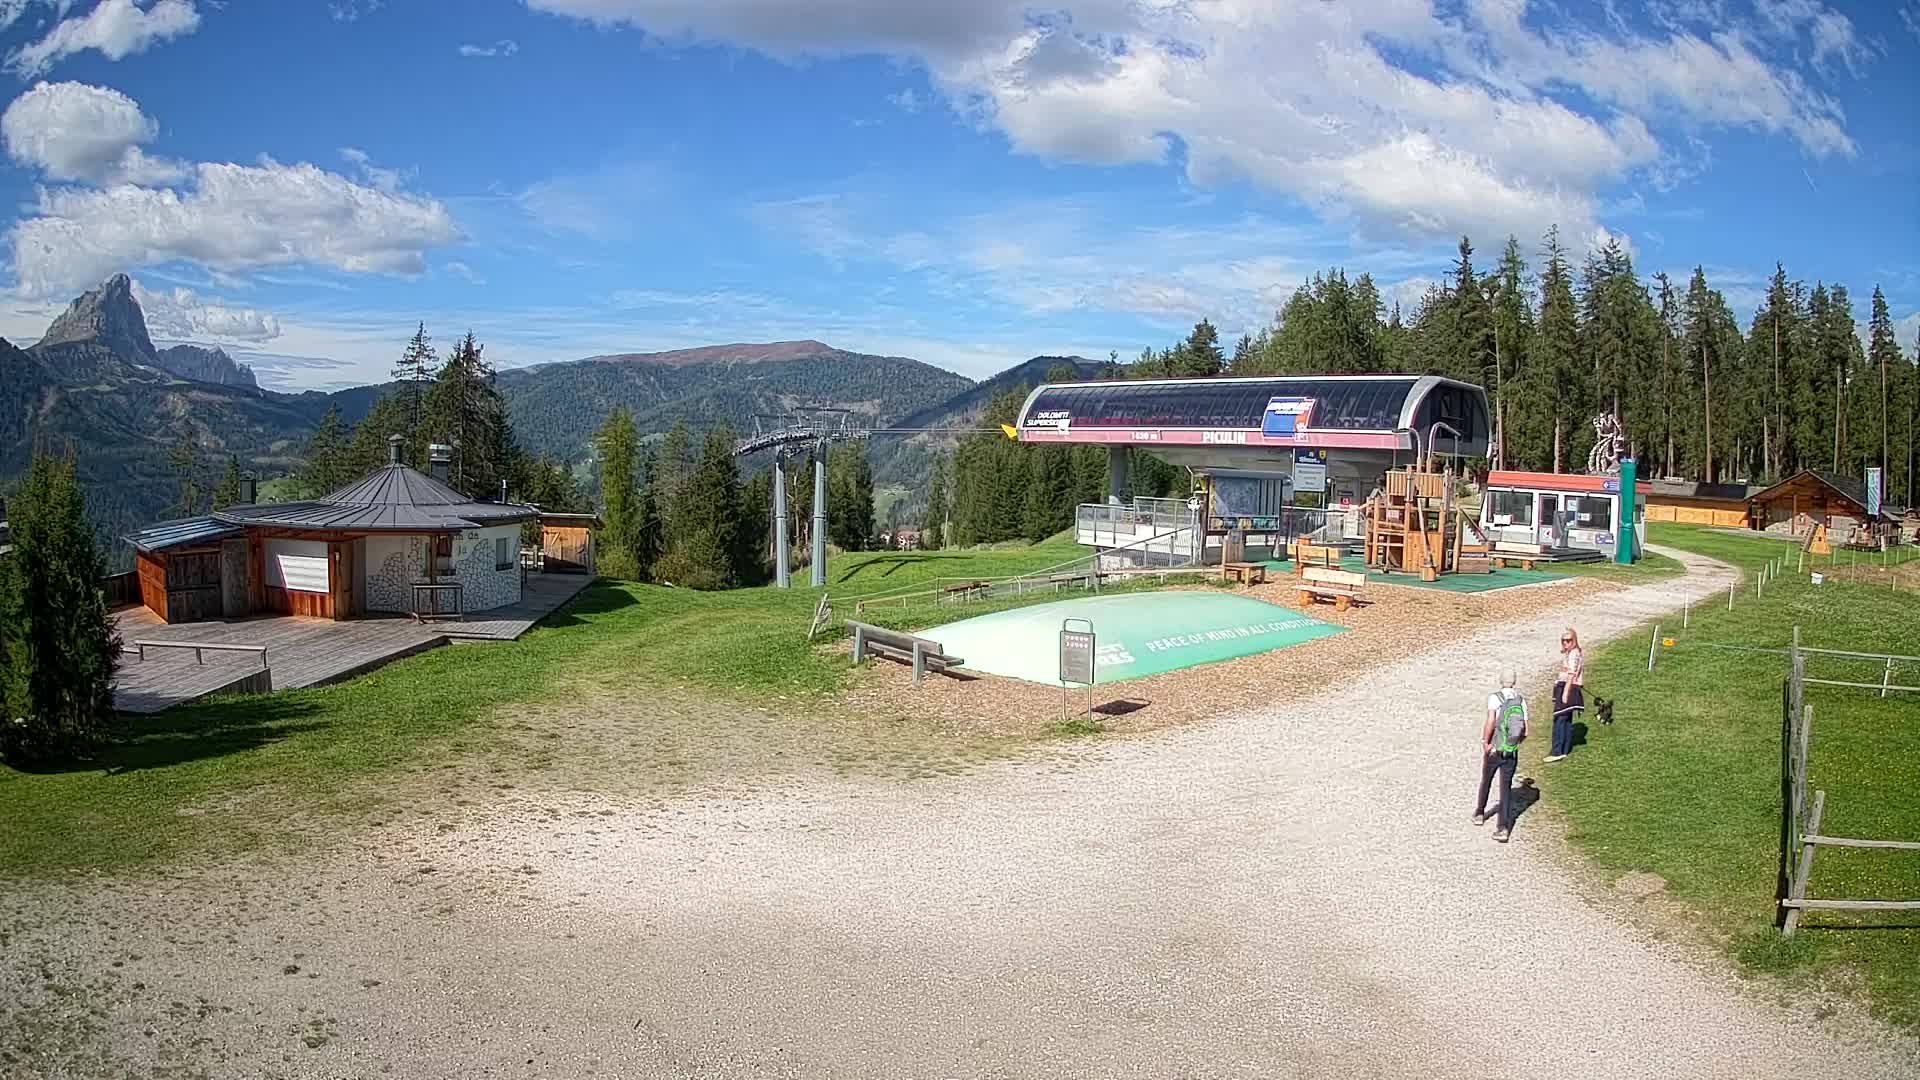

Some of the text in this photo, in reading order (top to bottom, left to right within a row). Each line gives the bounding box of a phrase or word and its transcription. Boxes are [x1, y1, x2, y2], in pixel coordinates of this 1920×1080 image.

[1202, 431, 1246, 444] PICULIN
[1145, 635, 1190, 652] PEACE
[1187, 632, 1206, 645] OF
[1205, 629, 1236, 642] MIND
[1234, 627, 1250, 641] IN
[1249, 623, 1269, 636] ALL
